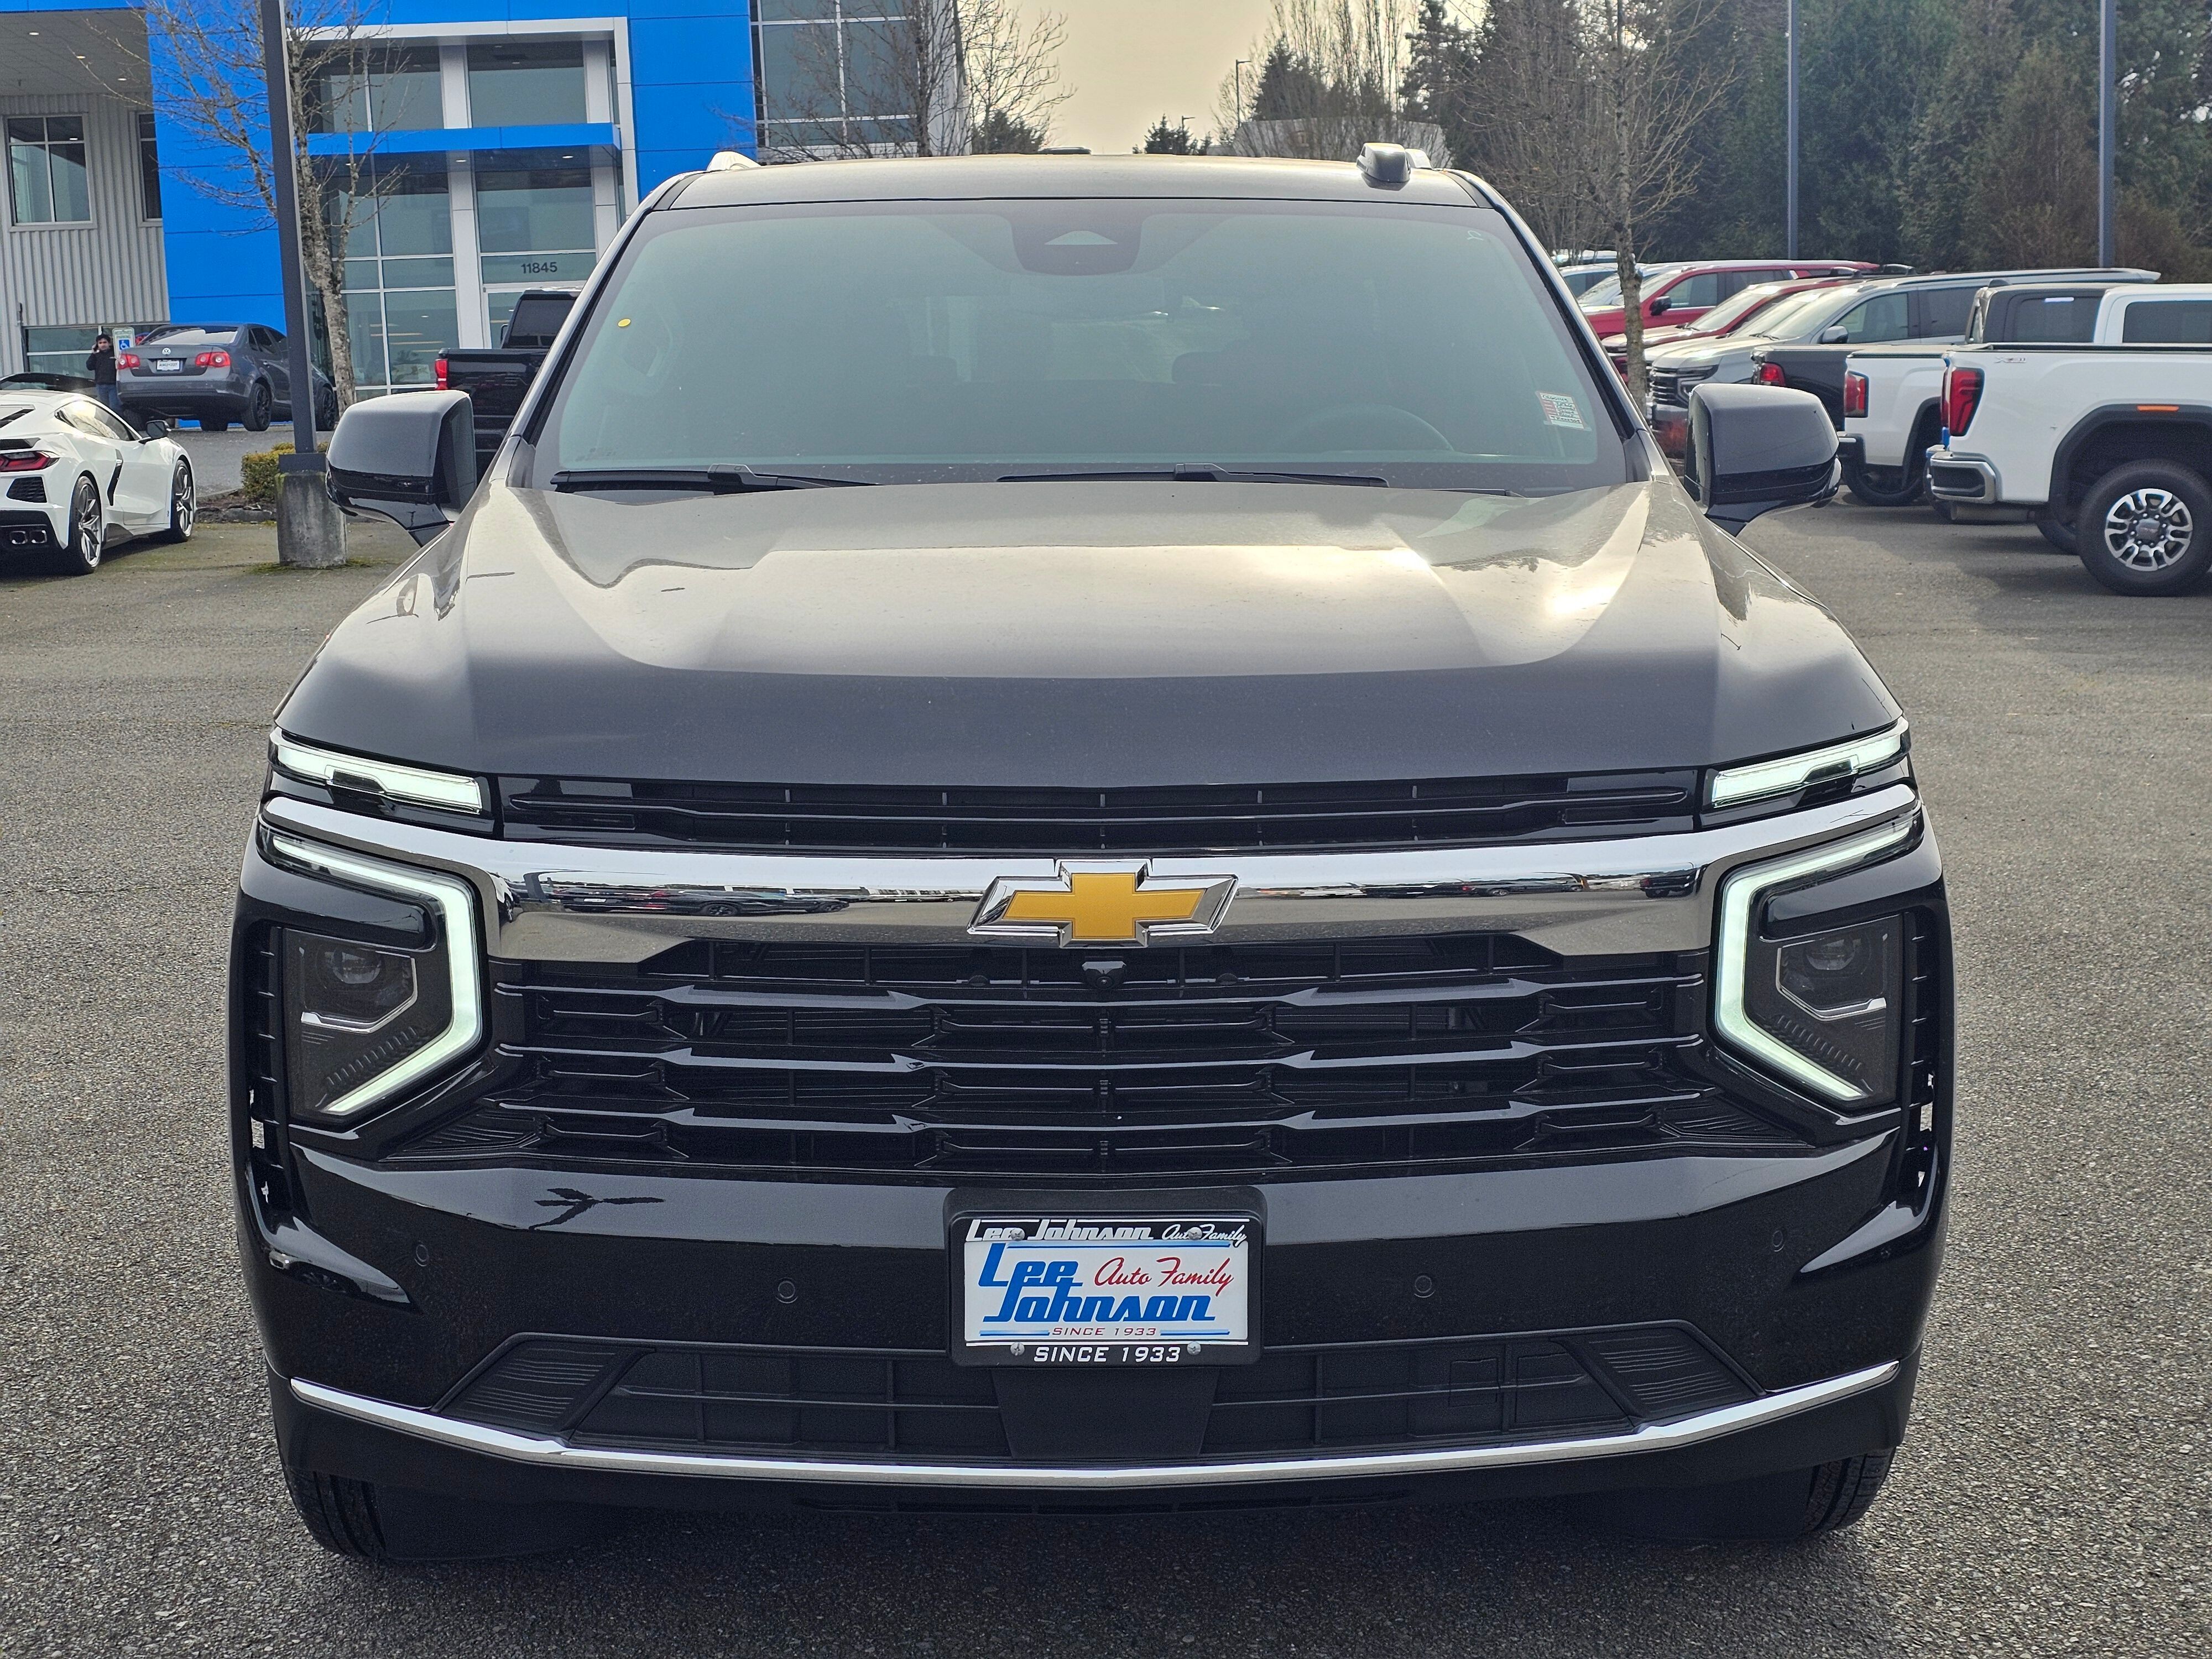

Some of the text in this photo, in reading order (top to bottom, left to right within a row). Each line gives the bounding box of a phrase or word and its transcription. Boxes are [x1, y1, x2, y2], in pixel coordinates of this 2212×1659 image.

[521, 262, 557, 274] 11845
[1027, 1219, 1154, 1240] Johnson
[1162, 1224, 1194, 1240] Aut
[1199, 1224, 1247, 1247] Family
[978, 1243, 1083, 1286] Lee
[1094, 1257, 1234, 1297] Auto Family
[983, 1282, 1215, 1322] Johnson
[1034, 1347, 1181, 1362] SINCE 1933
